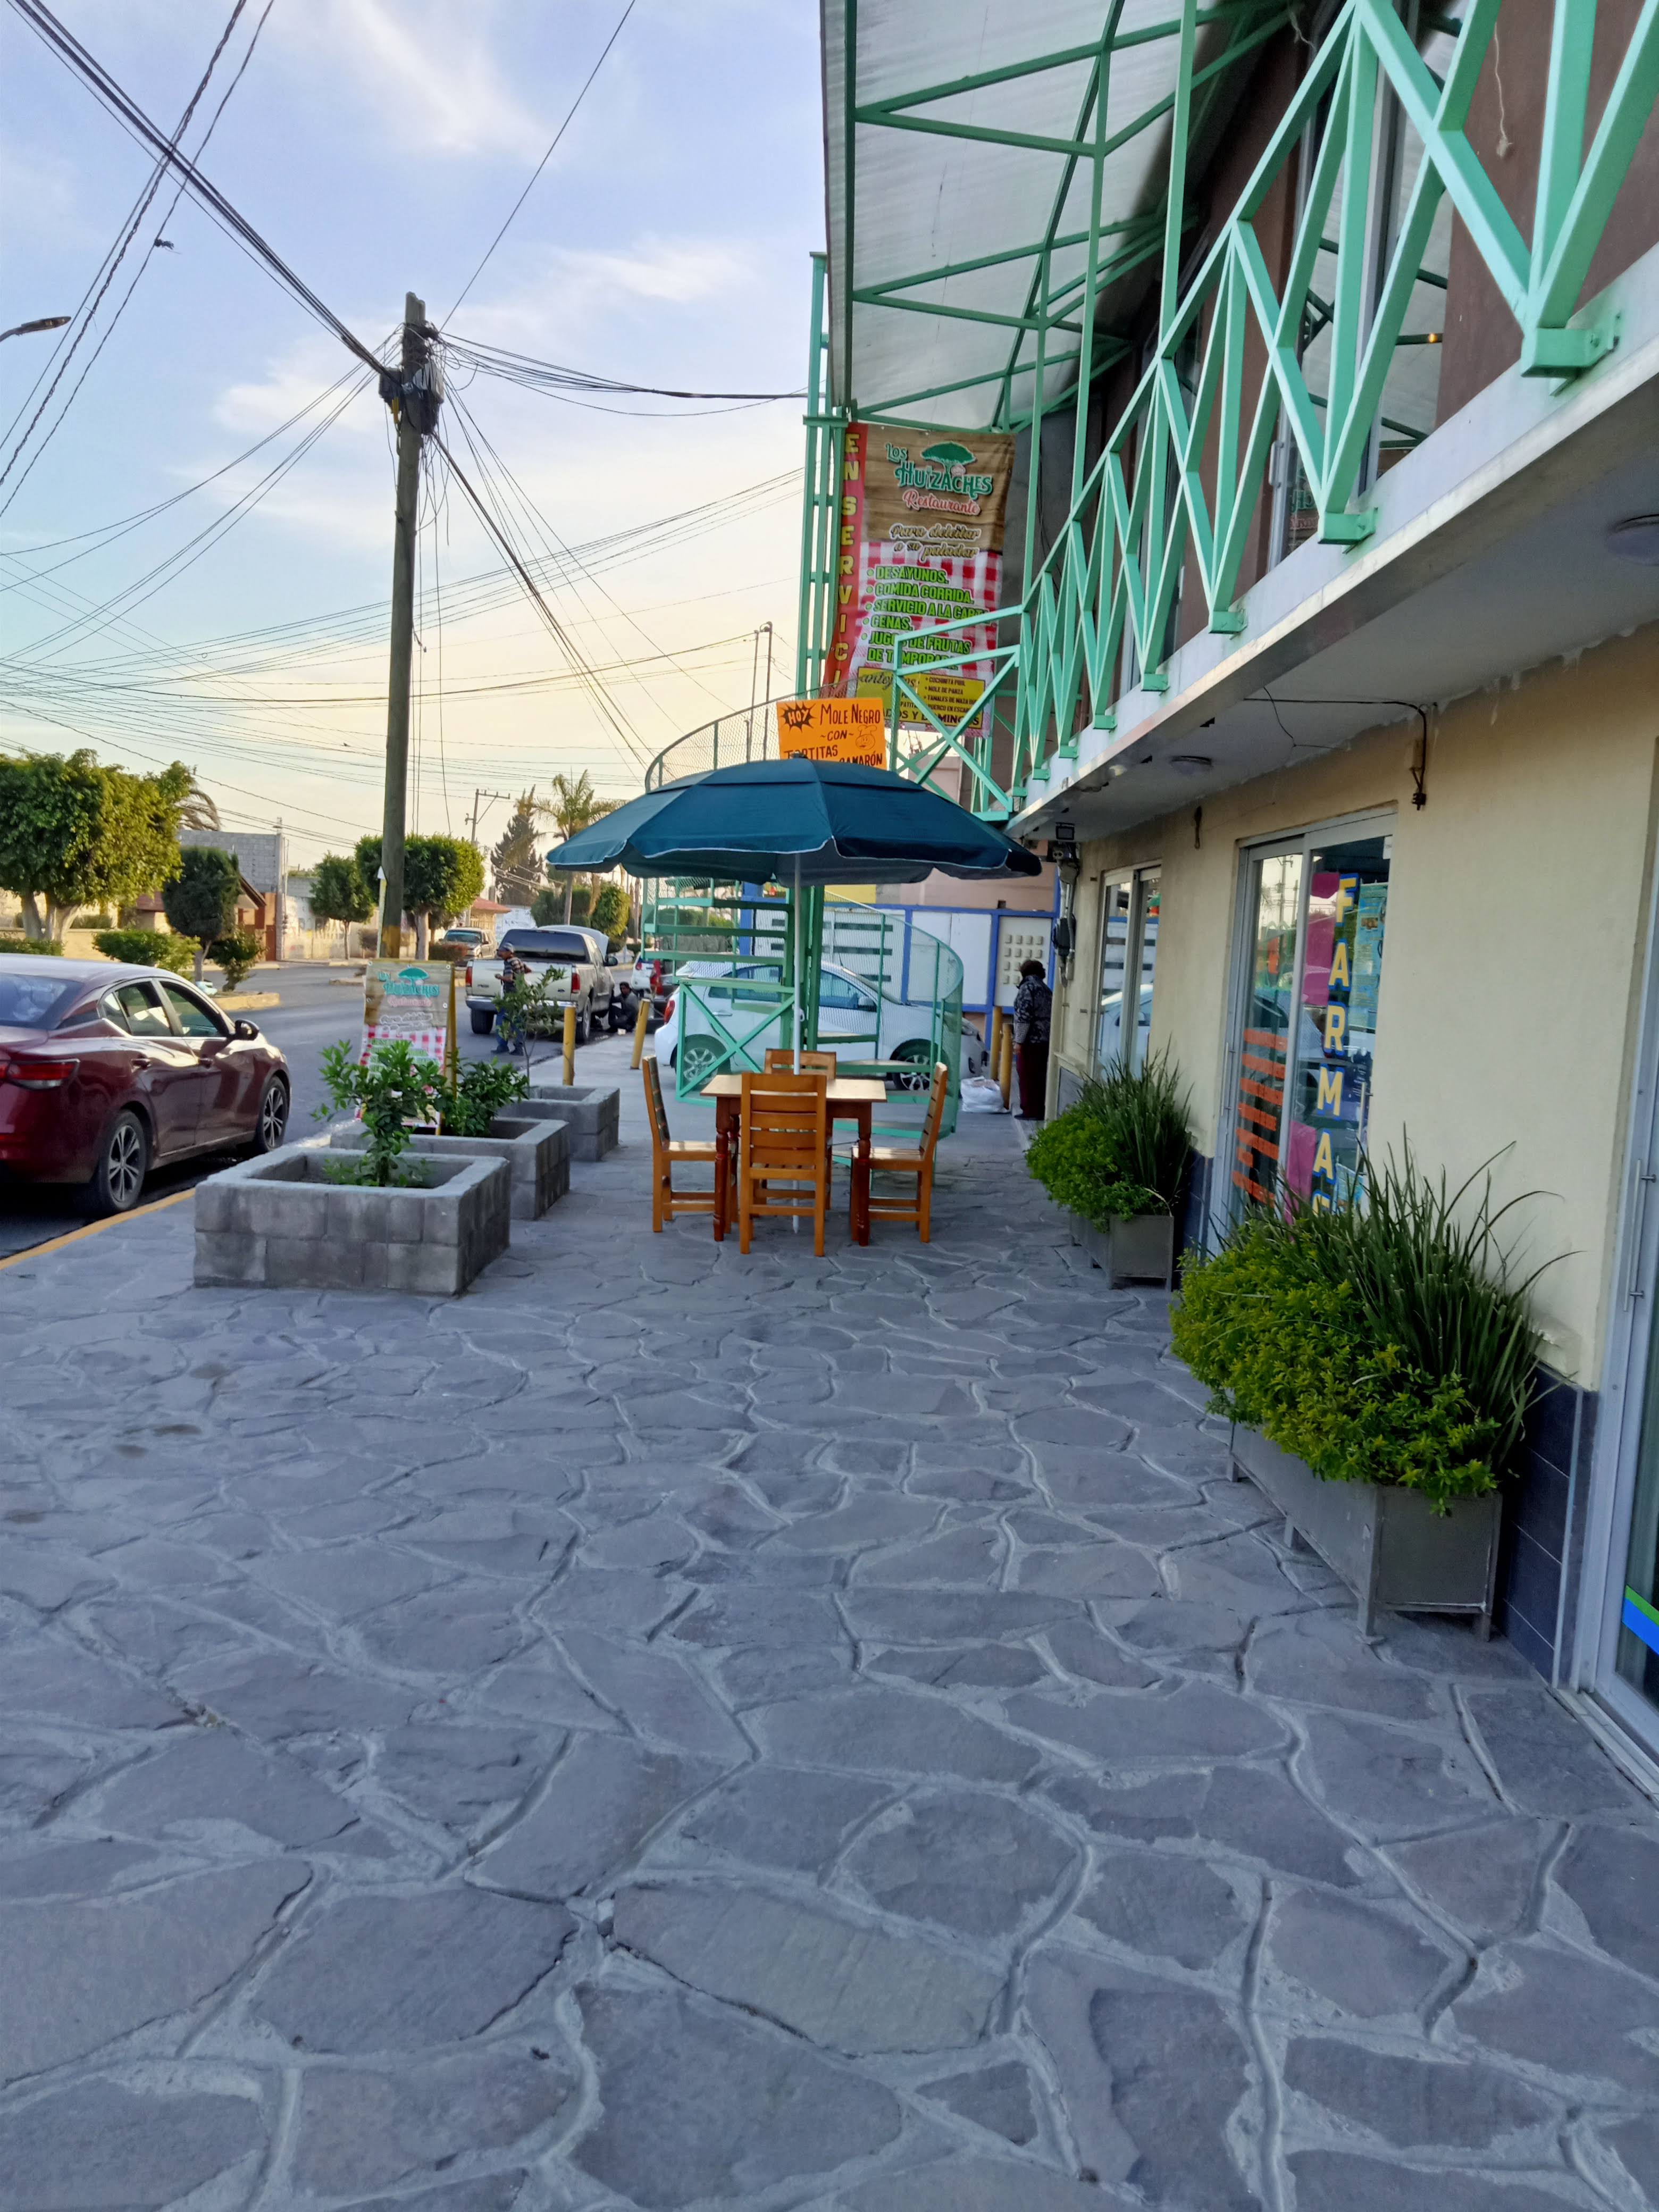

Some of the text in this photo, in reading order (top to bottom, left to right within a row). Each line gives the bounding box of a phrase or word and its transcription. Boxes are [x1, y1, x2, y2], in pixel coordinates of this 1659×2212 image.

[843, 433, 860, 481] EN
[902, 489, 981, 515] Restaurante
[890, 523, 927, 539] Para
[893, 541, 979, 563] a su paladar
[876, 566, 950, 584] DESAYUNOS.
[875, 582, 975, 605] COMIDA CORRIDA.
[873, 599, 927, 615] SERVICIO
[927, 602, 936, 617] A
[936, 604, 952, 618] LA
[870, 615, 914, 631] CENAS.
[867, 648, 884, 662] DE
[926, 636, 971, 655] FRUTAS
[787, 709, 809, 725] HOY
